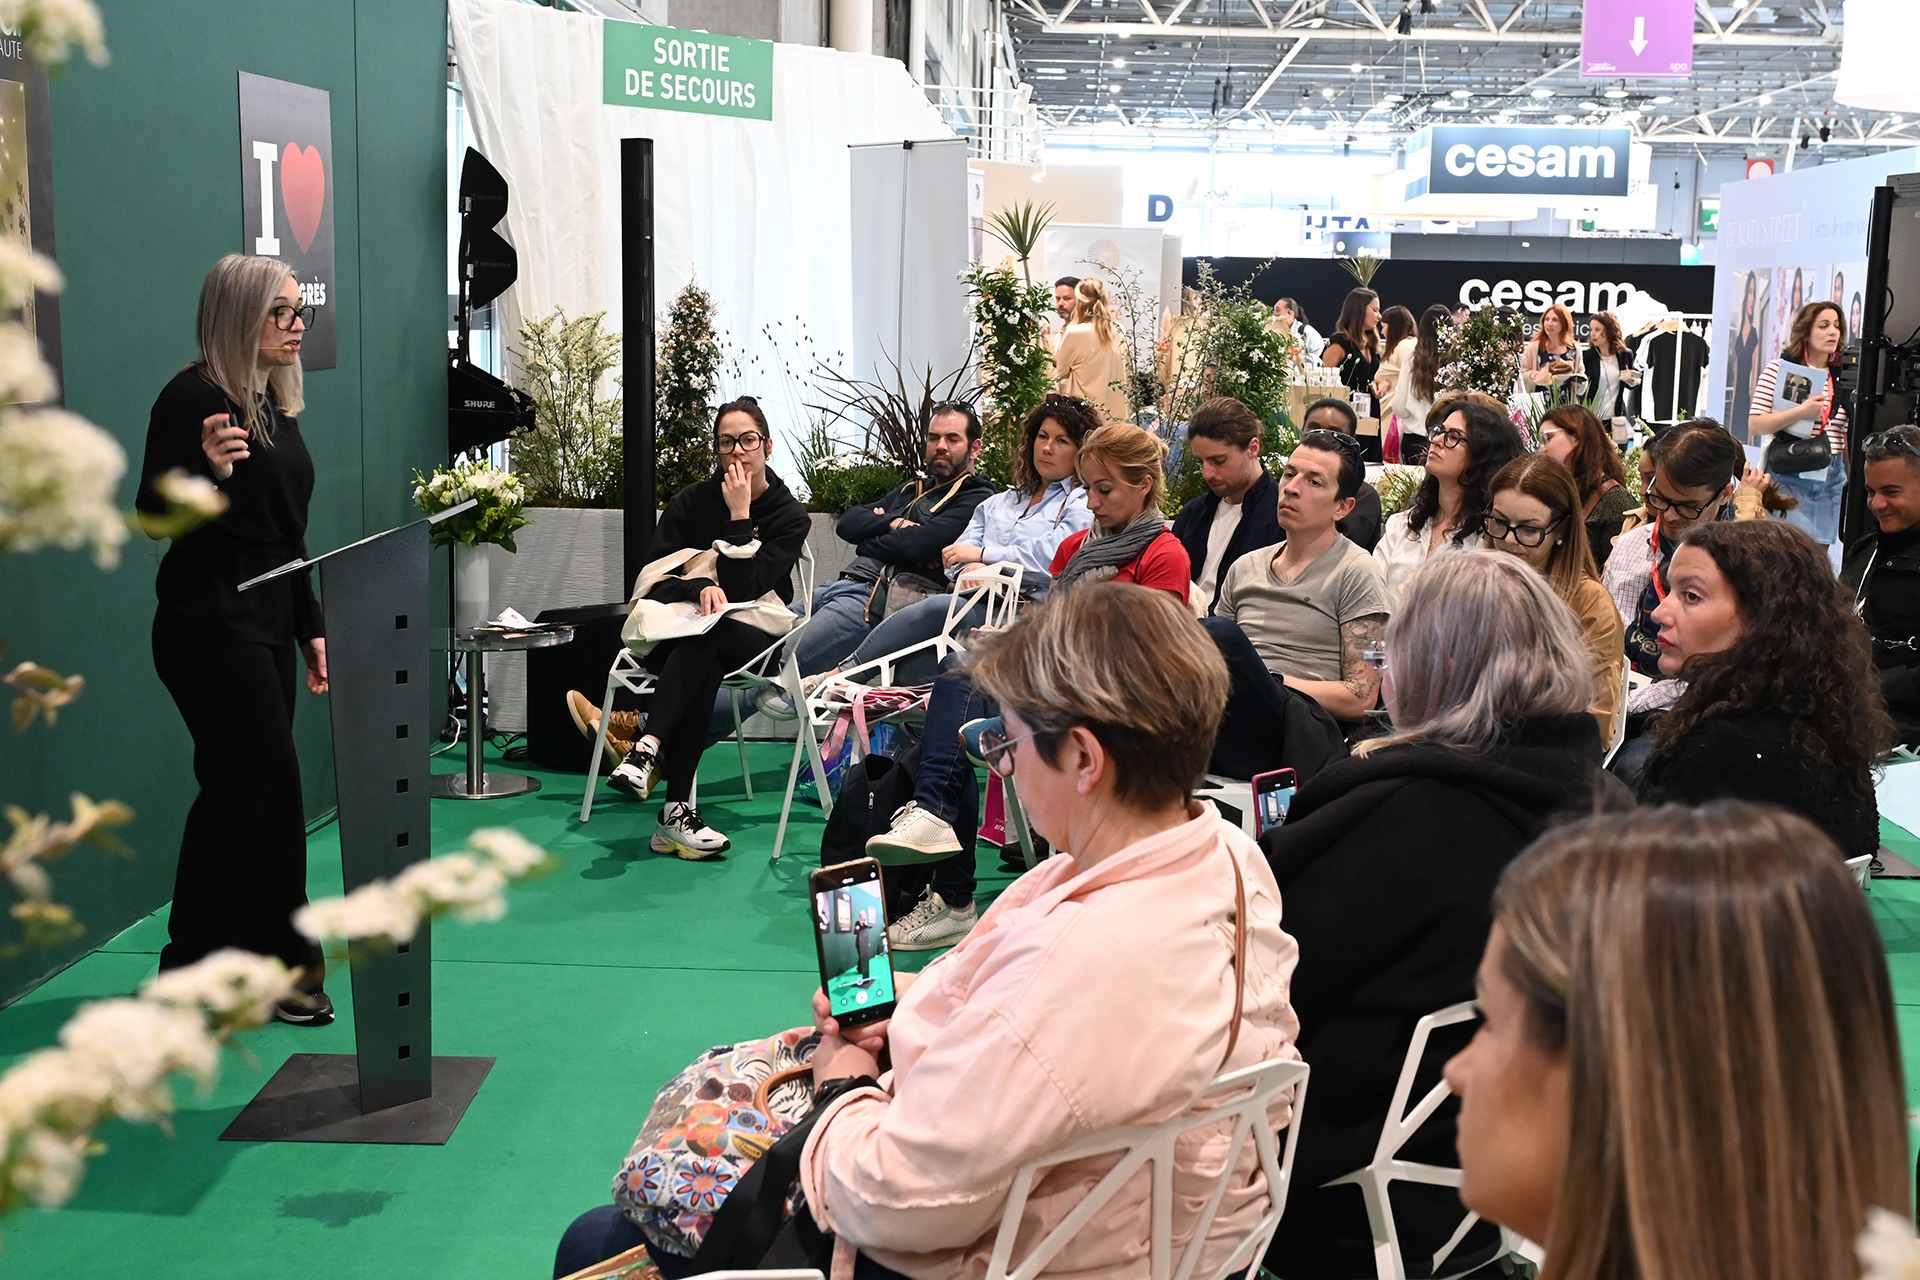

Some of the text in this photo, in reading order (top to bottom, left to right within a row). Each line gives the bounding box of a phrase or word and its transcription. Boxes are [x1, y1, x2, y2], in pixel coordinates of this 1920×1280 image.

[0, 38, 22, 60] AUTE
[653, 37, 730, 72] SORTIE
[1670, 63, 1688, 72] spa
[625, 68, 756, 109] DE SECOURS
[1445, 144, 1615, 179] cesam
[253, 140, 280, 256] I
[1148, 194, 1174, 223] D
[1726, 213, 1802, 248] BEAUTY STREET
[299, 276, 327, 306] GRÈS
[1459, 279, 1637, 314] cesam
[464, 400, 496, 409] SHURE
